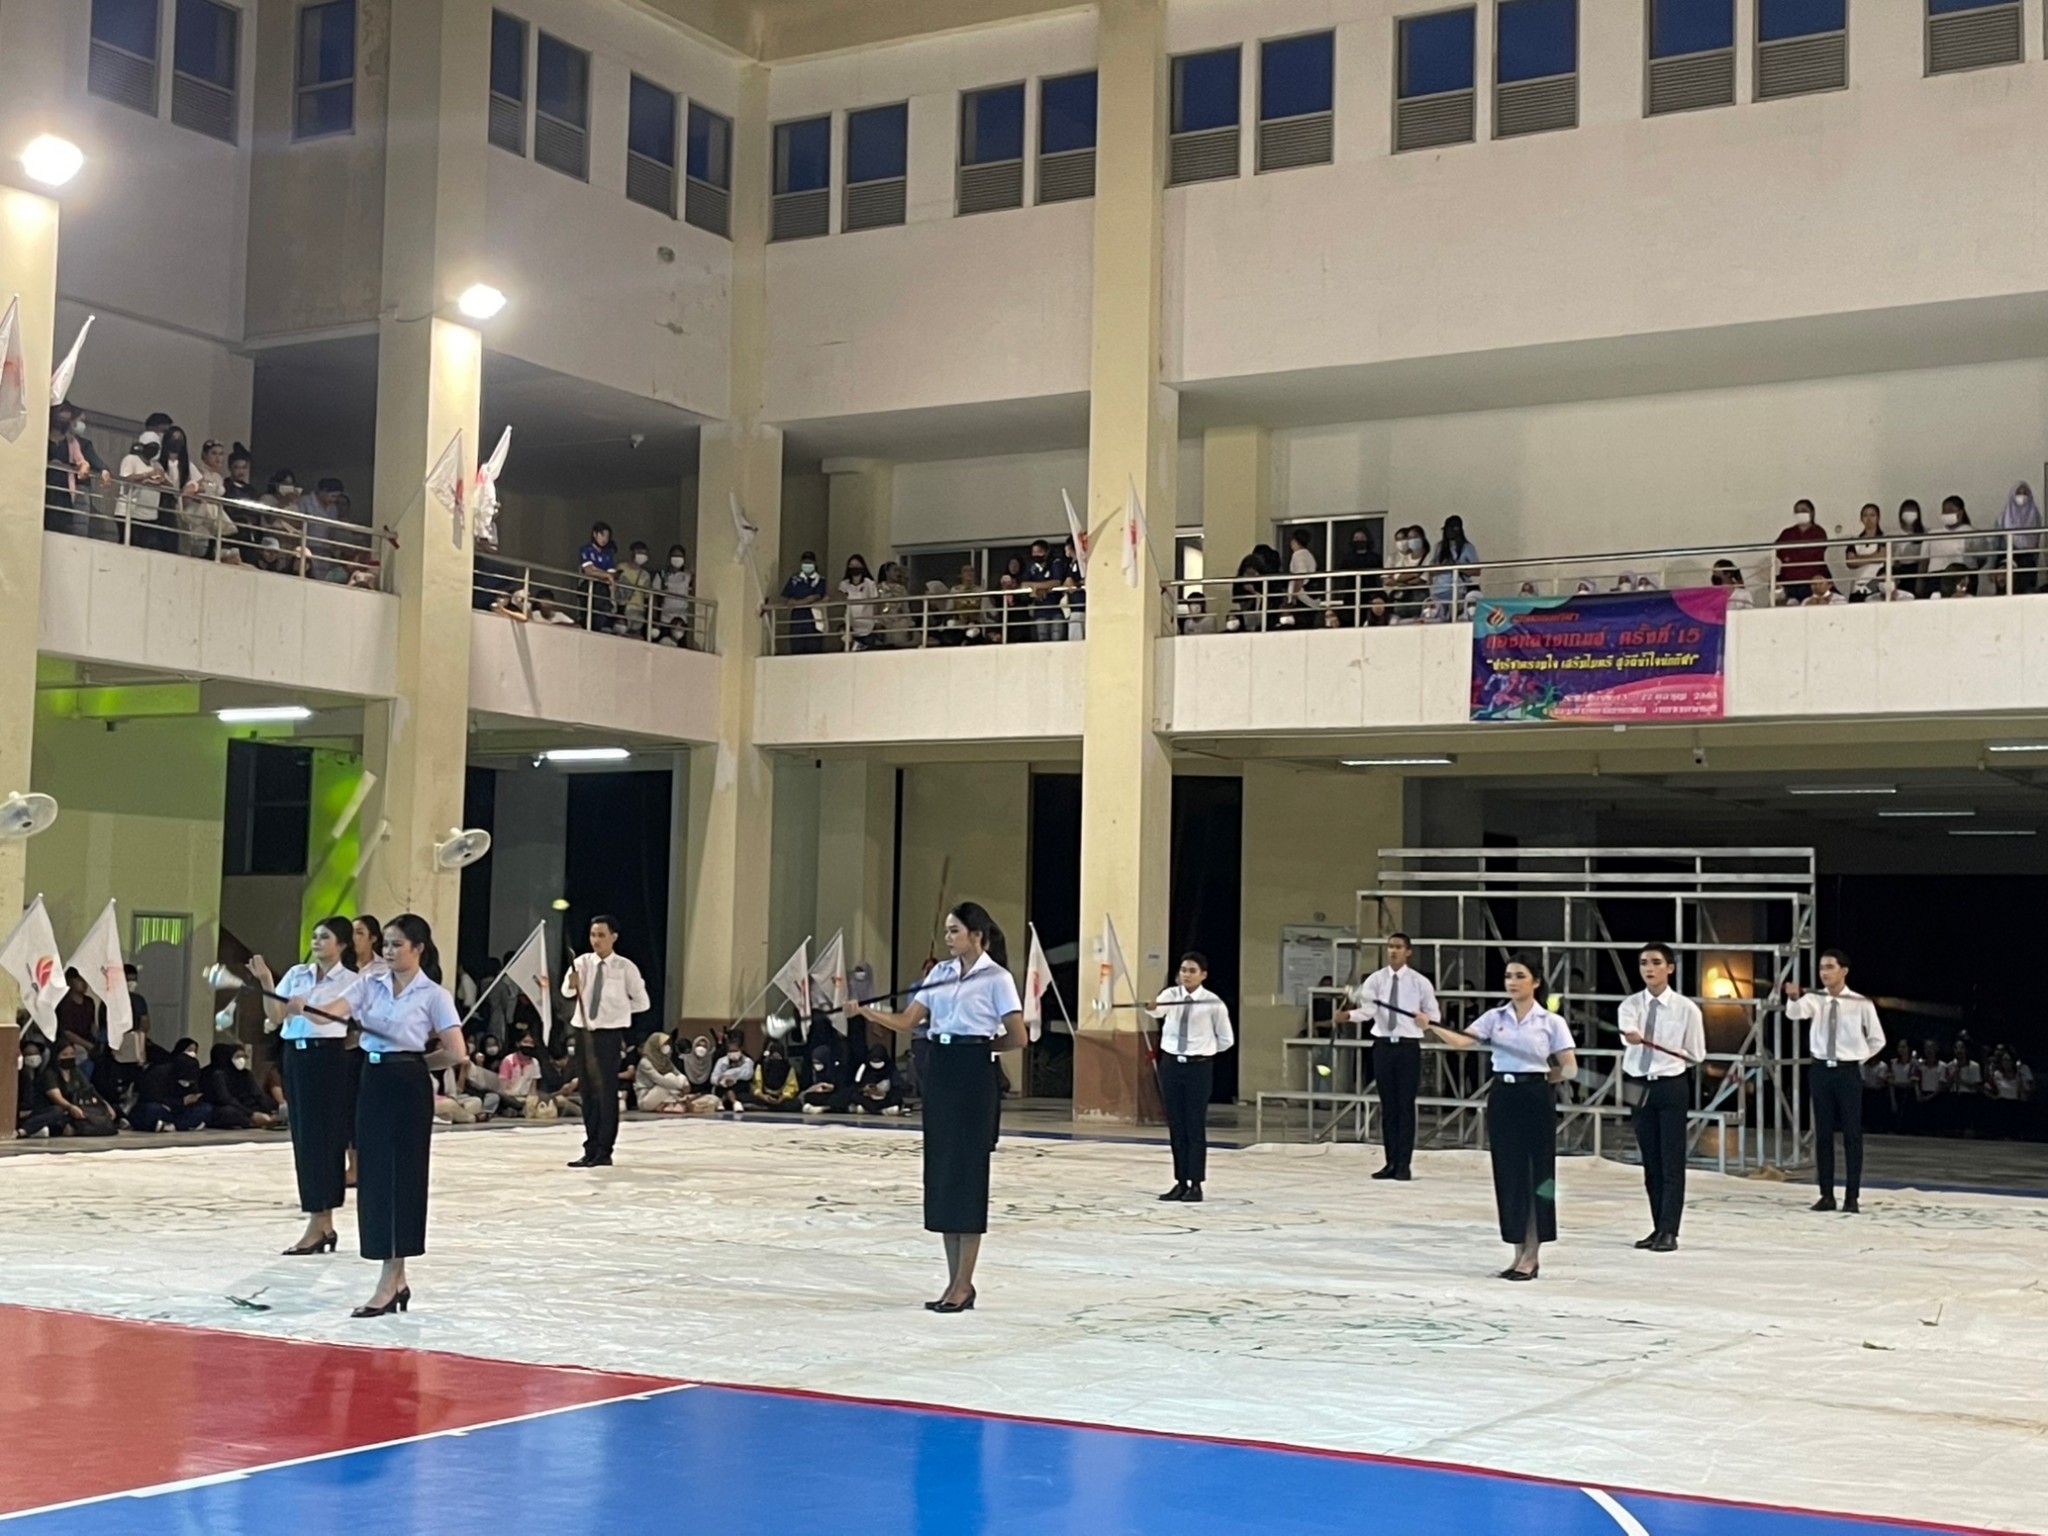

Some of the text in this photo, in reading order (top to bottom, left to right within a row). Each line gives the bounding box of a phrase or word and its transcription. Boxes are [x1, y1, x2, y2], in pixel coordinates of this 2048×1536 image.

[1619, 622, 1673, 645] ครั้งที่
[1678, 627, 1701, 643] 15
